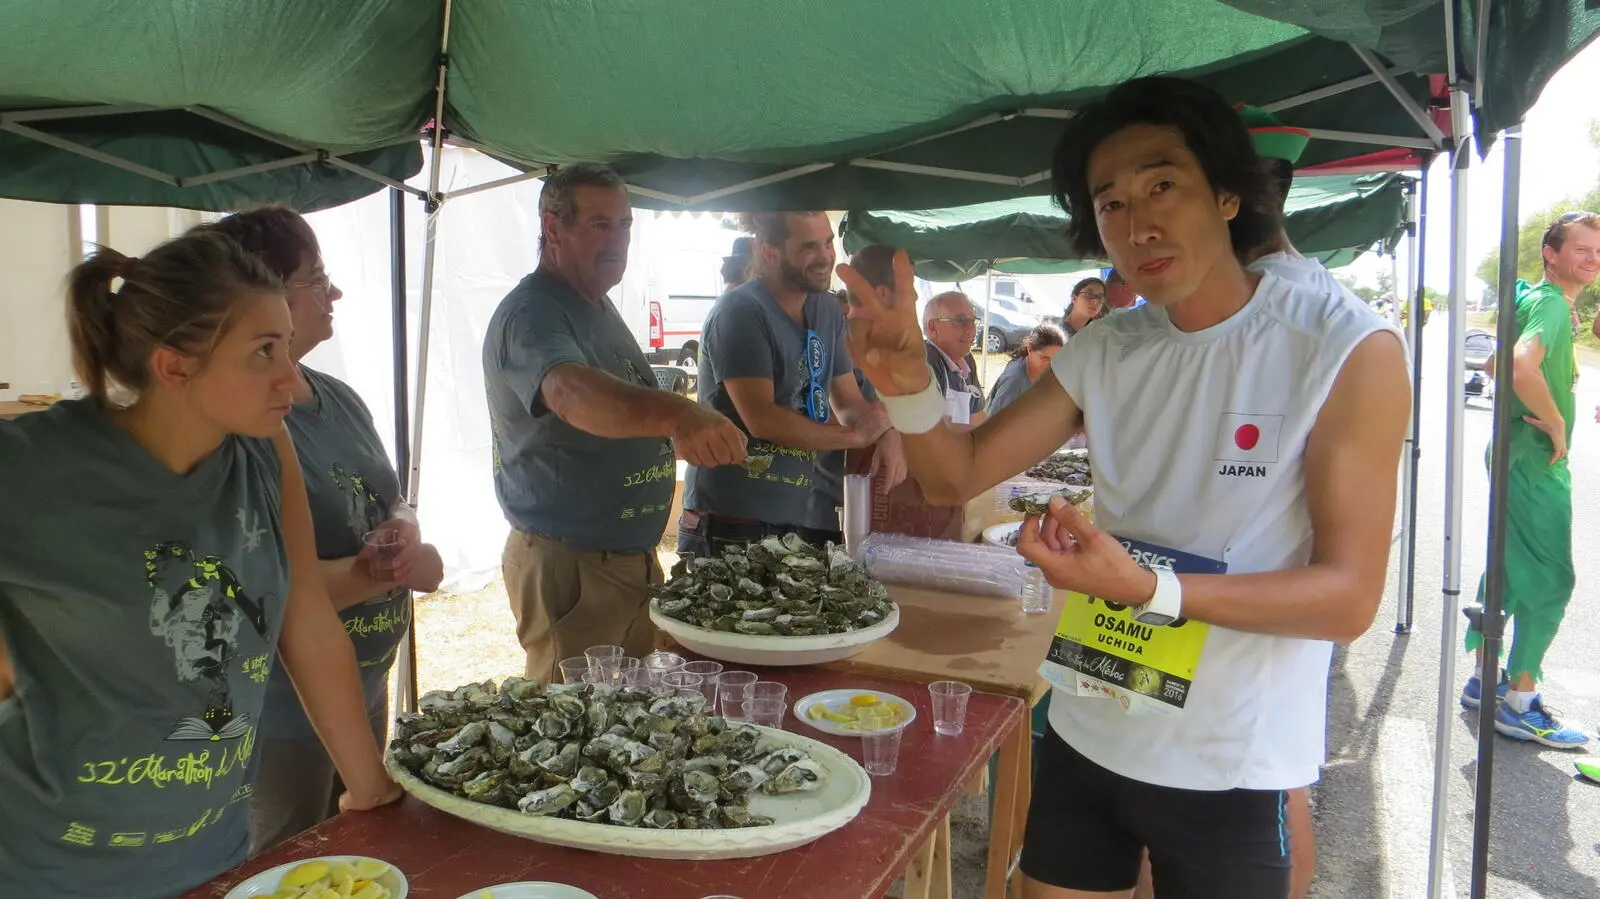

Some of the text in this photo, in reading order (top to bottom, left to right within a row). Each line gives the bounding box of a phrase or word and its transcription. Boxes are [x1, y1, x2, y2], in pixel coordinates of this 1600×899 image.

[1218, 464, 1267, 477] JAPAN
[1094, 613, 1153, 641] OSAMU
[1097, 633, 1143, 655] UCHIDA
[1163, 687, 1184, 701] 2016
[127, 749, 214, 789] Marathon
